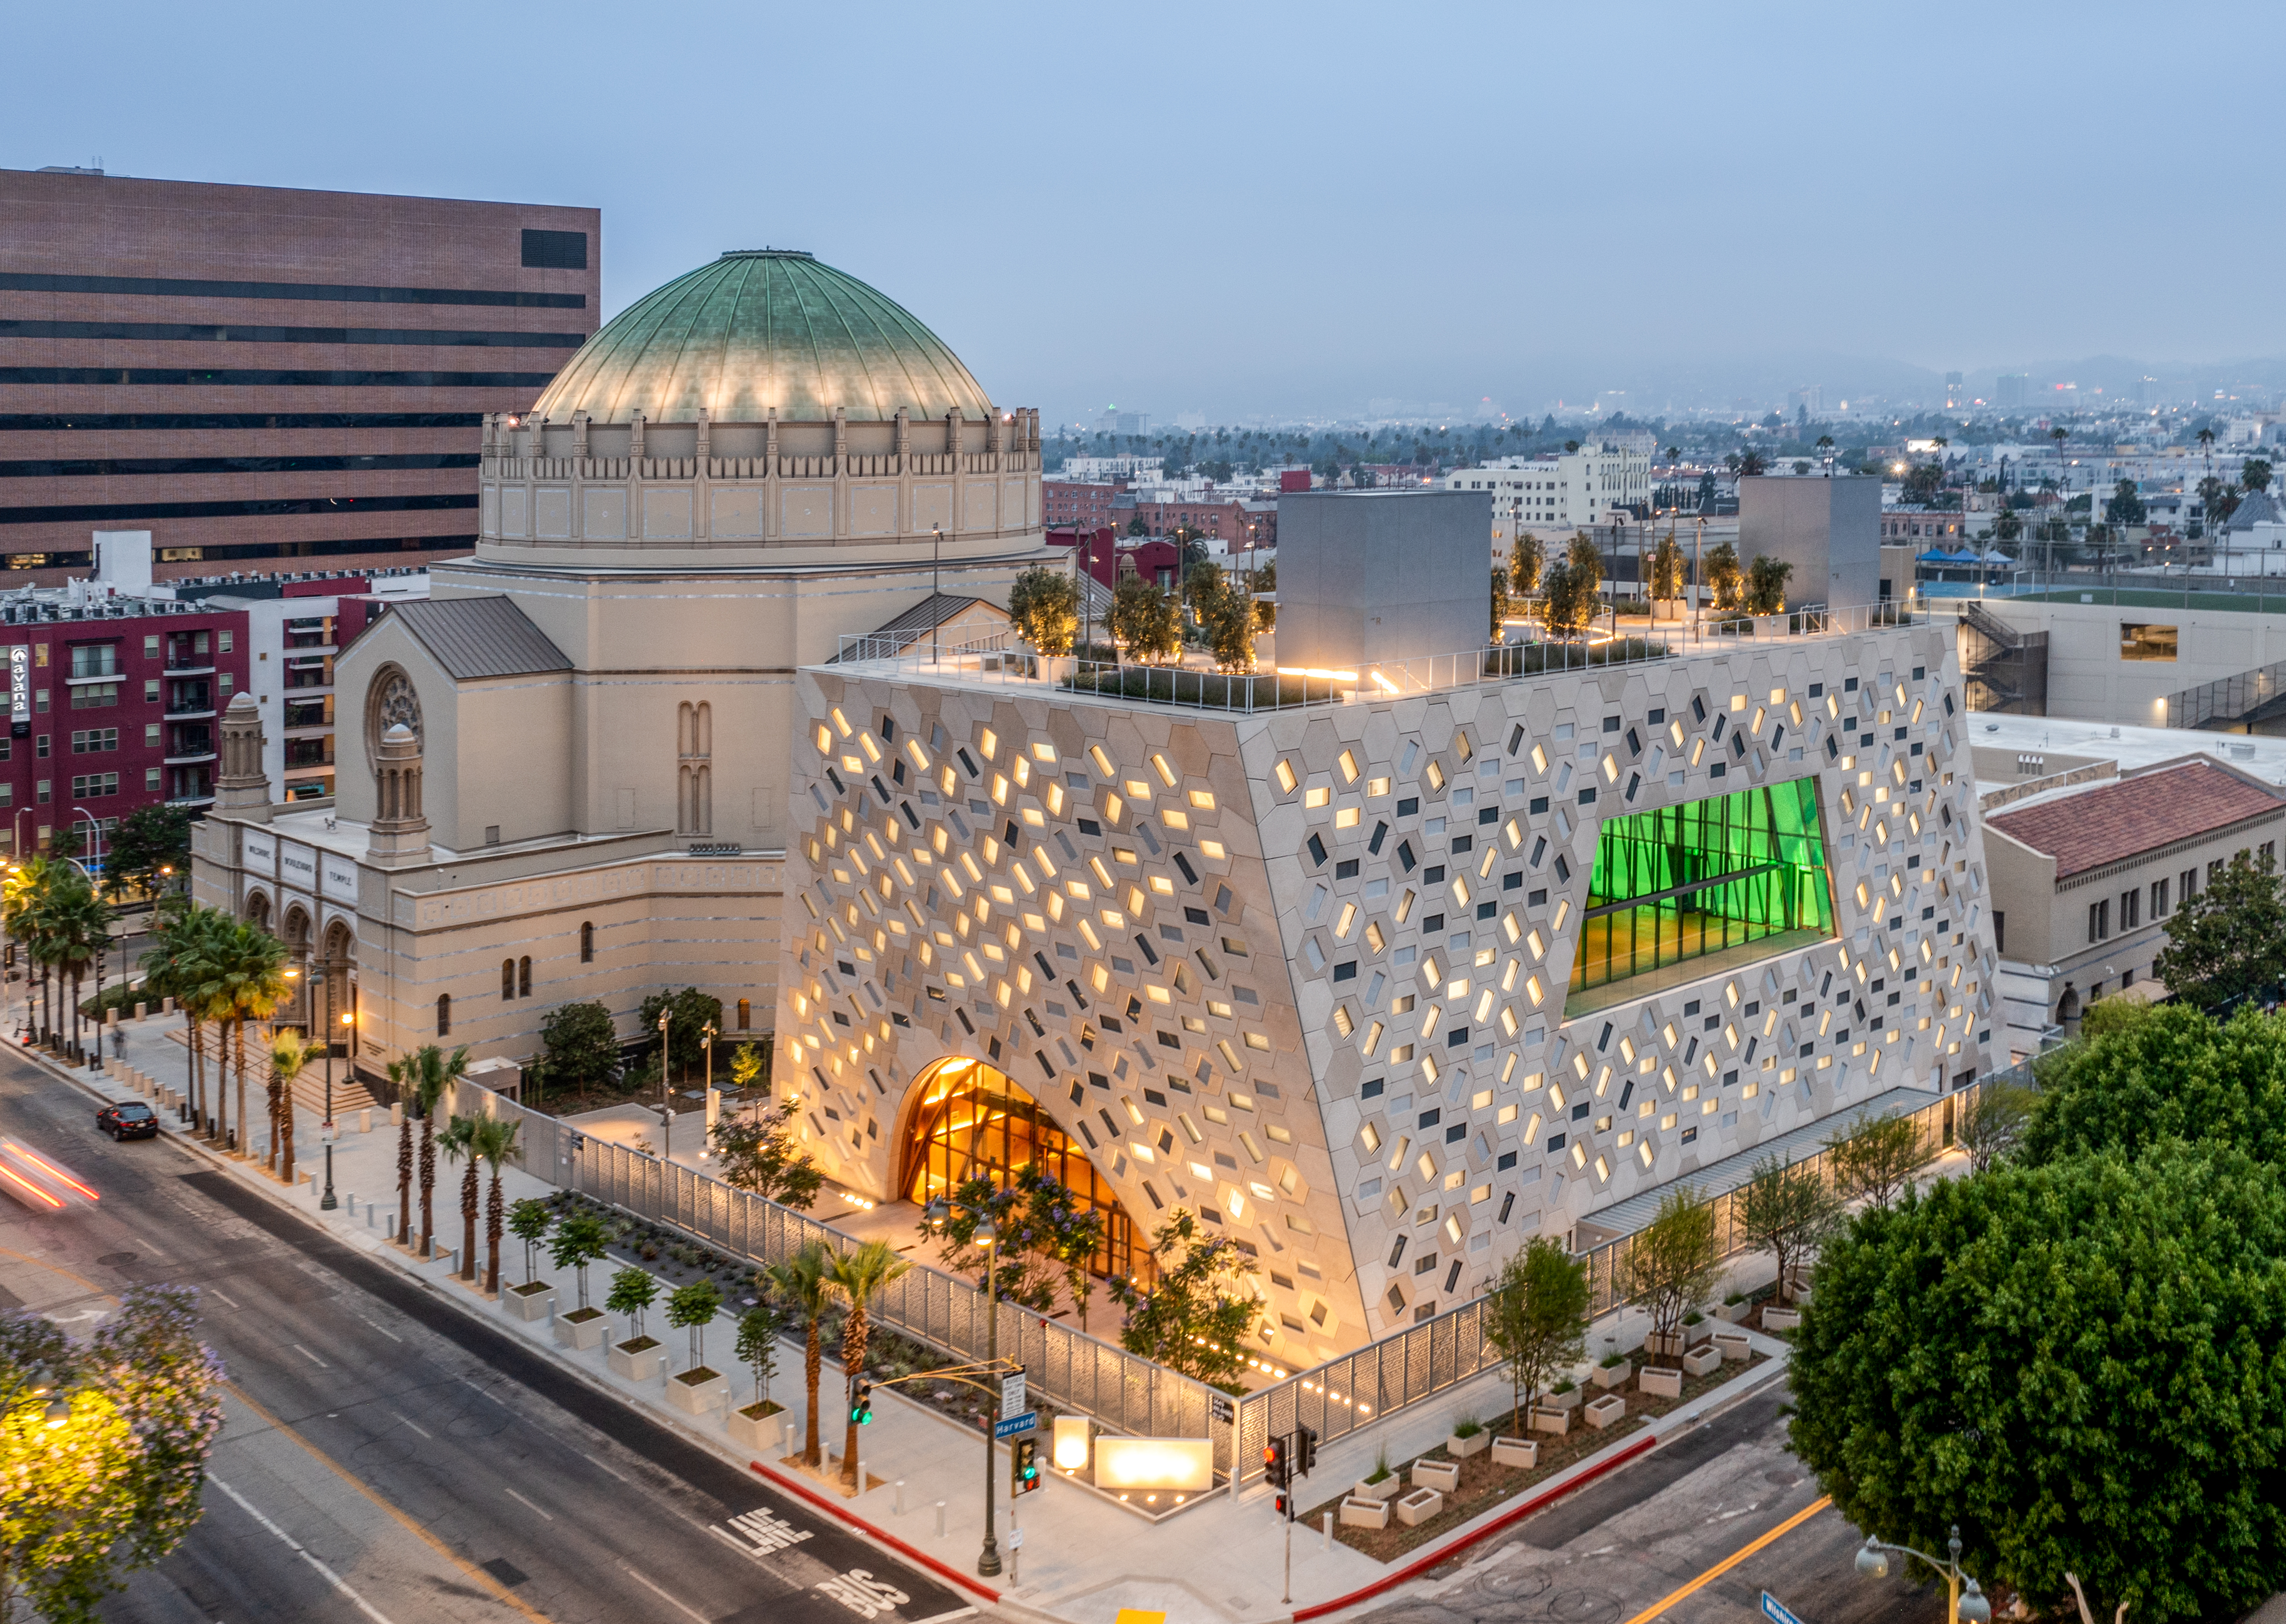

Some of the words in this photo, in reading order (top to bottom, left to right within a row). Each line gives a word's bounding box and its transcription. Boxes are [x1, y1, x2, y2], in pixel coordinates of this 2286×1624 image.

[13, 665, 26, 711] avana
[329, 871, 352, 886] TEMPLE
[996, 1416, 1034, 1435] Harvard
[709, 1506, 815, 1557] LANE
[815, 1569, 911, 1620] BUS
